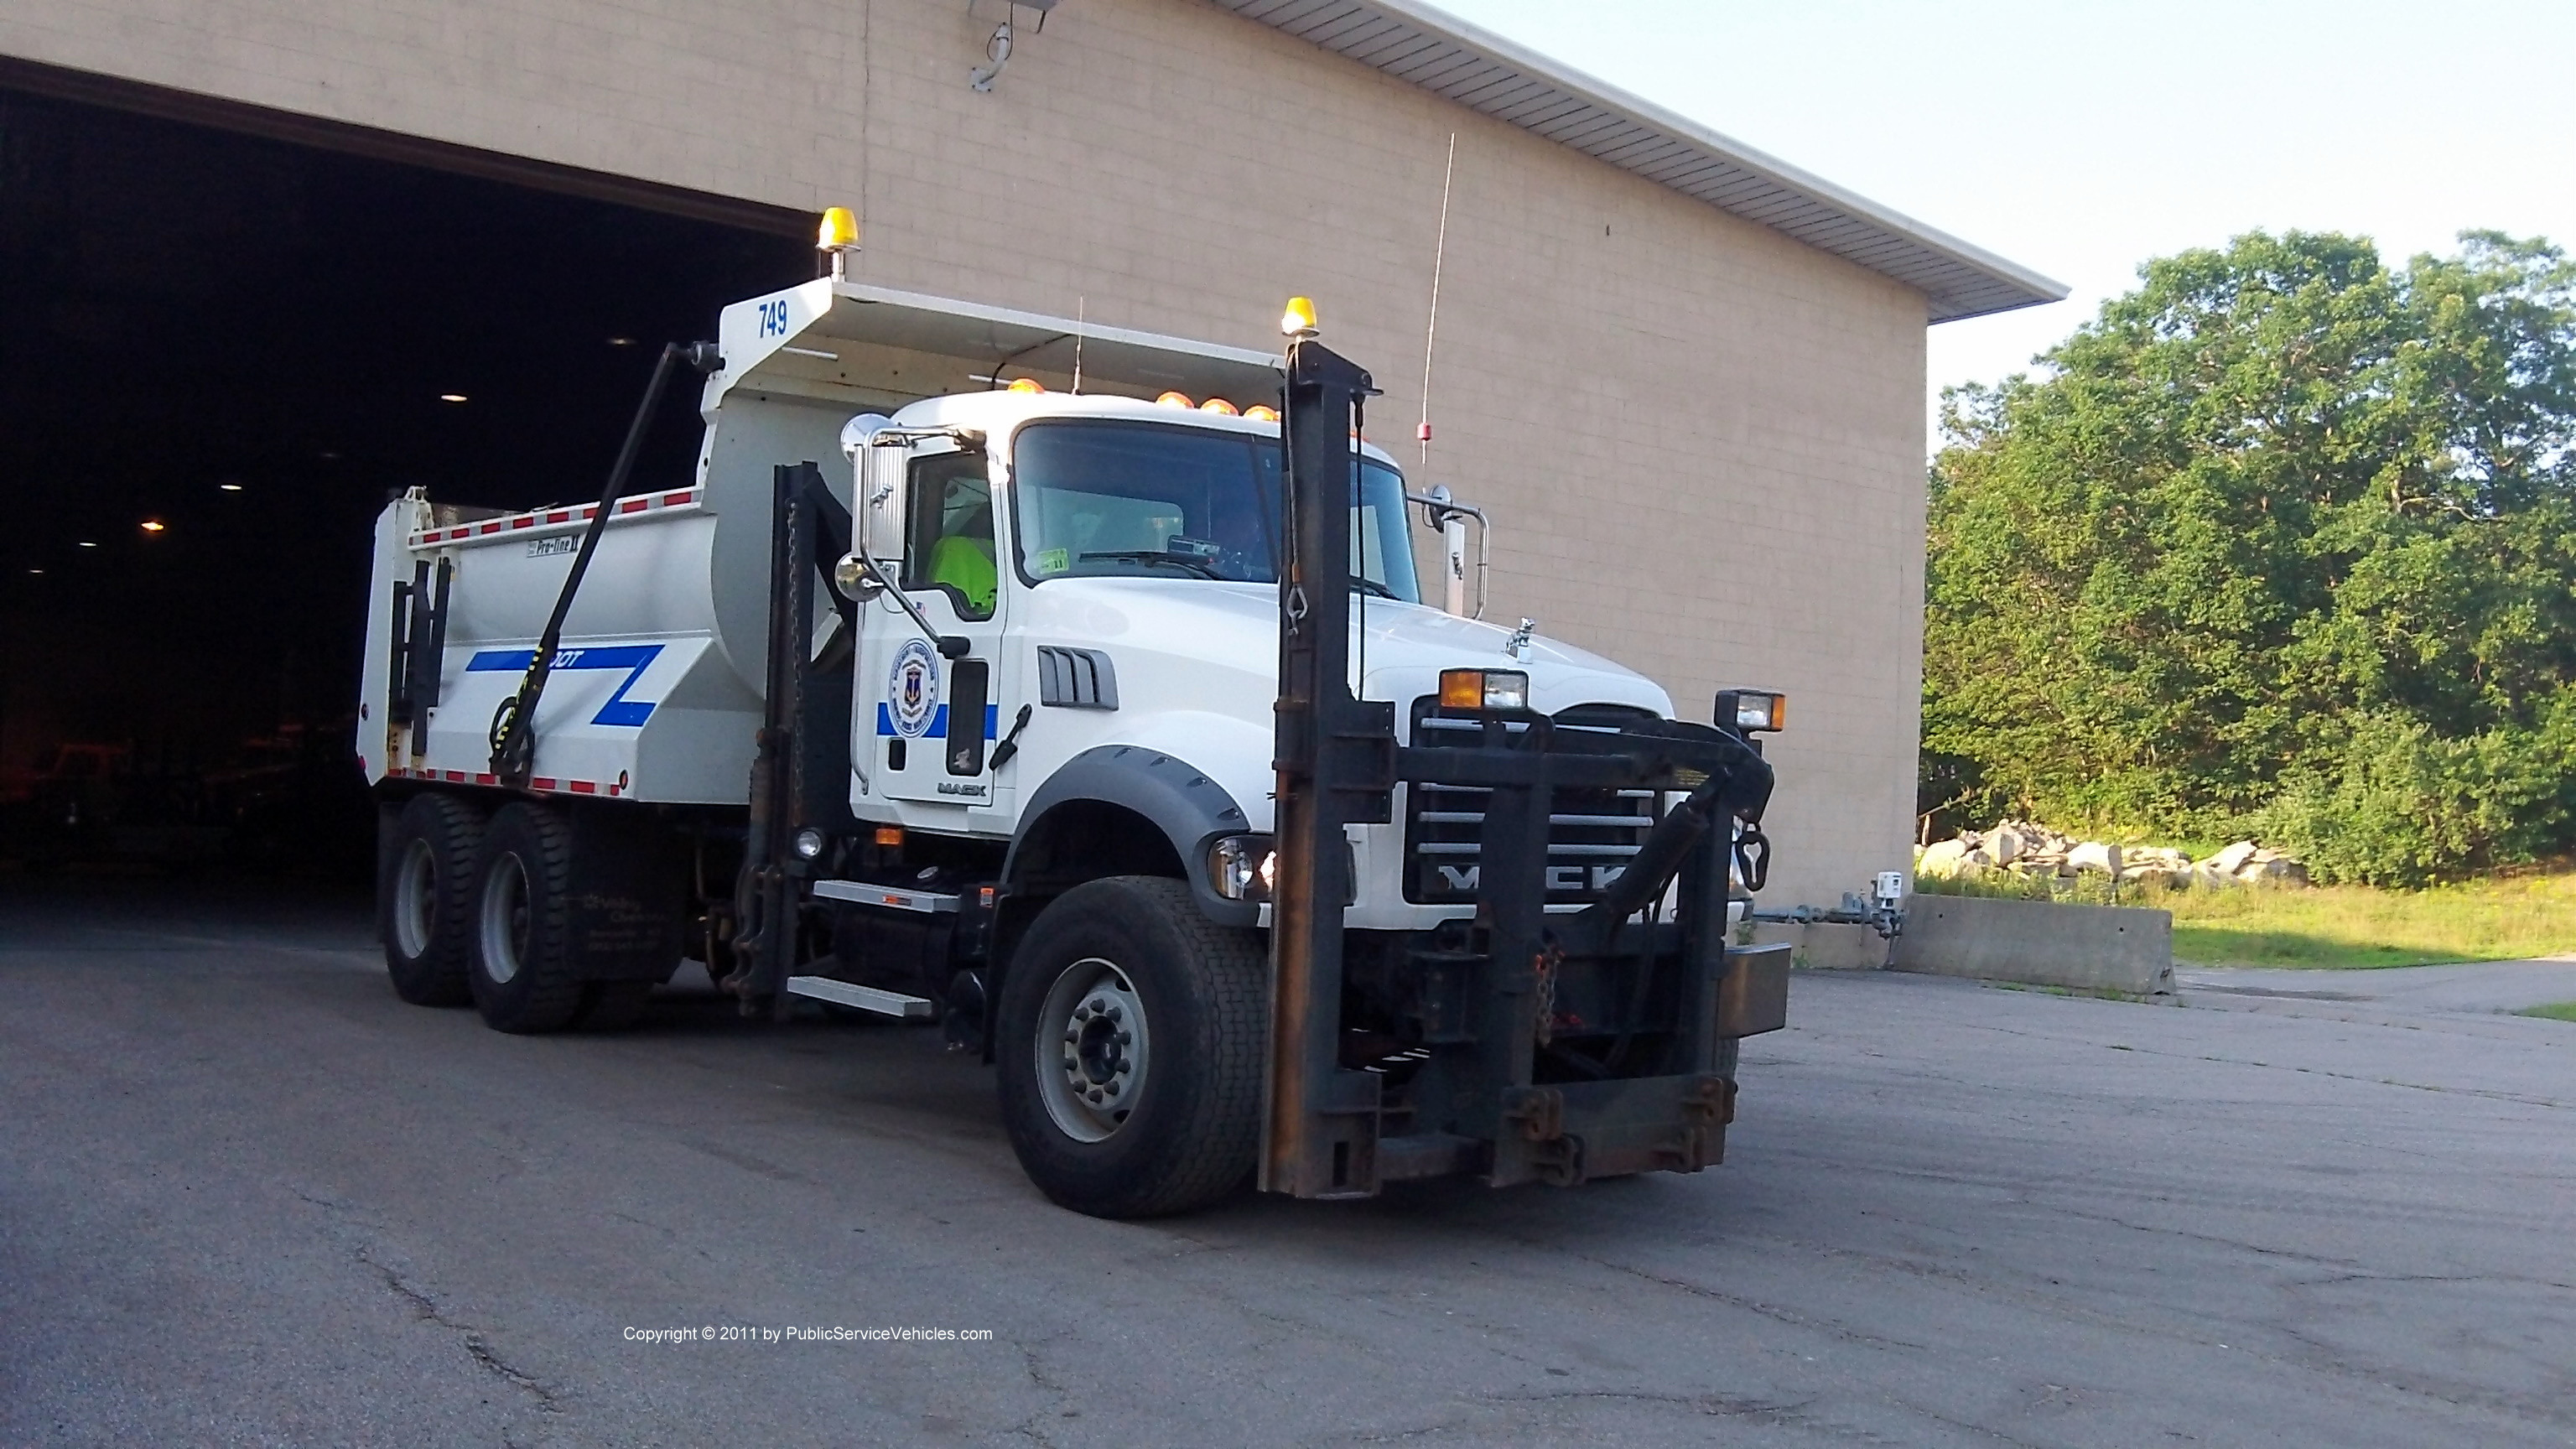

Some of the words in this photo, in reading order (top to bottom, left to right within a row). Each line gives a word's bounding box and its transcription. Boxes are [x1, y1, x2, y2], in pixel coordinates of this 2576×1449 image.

[759, 299, 787, 339] 749
[937, 782, 986, 797] MACK
[1438, 865, 1628, 890] MCK
